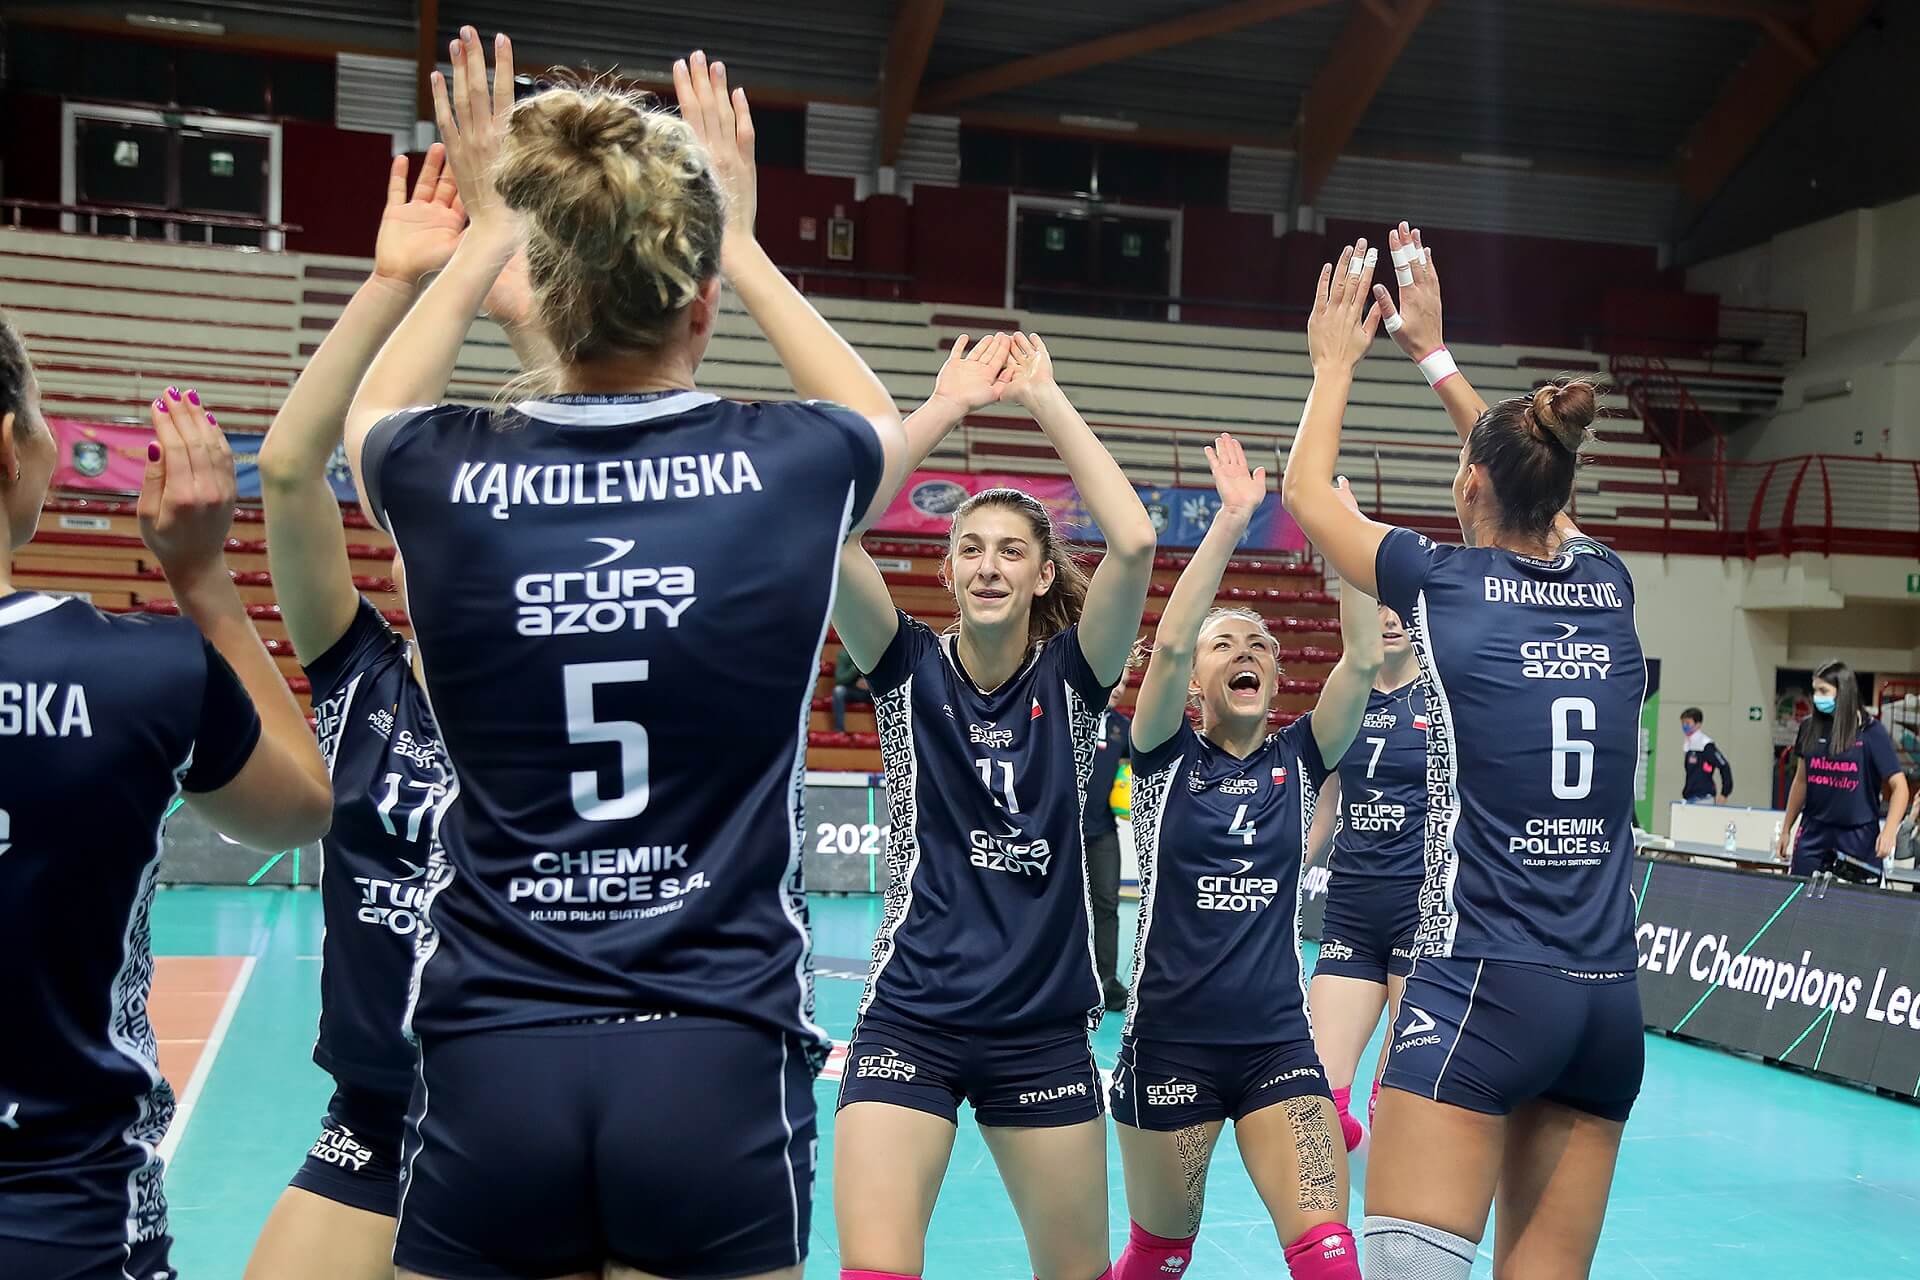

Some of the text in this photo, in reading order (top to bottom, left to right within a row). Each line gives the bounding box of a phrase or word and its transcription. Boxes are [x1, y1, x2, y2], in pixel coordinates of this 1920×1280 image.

[451, 450, 763, 519] KĄKOLEWSKA
[1484, 576, 1623, 608] BRAKOCEVIC
[563, 659, 649, 821] 5
[1366, 736, 1386, 779] 7
[1551, 696, 1597, 800] 6
[975, 757, 1021, 814] 11
[1228, 804, 1257, 846] 4
[1508, 836, 1588, 855] POLICE
[1525, 818, 1606, 836] CHEMIK
[532, 844, 689, 875] CHEMIK
[509, 876, 654, 904] POLICE
[530, 910, 567, 922] KLUB
[1635, 922, 1691, 976] CEV
[1689, 933, 1862, 1015] Champions
